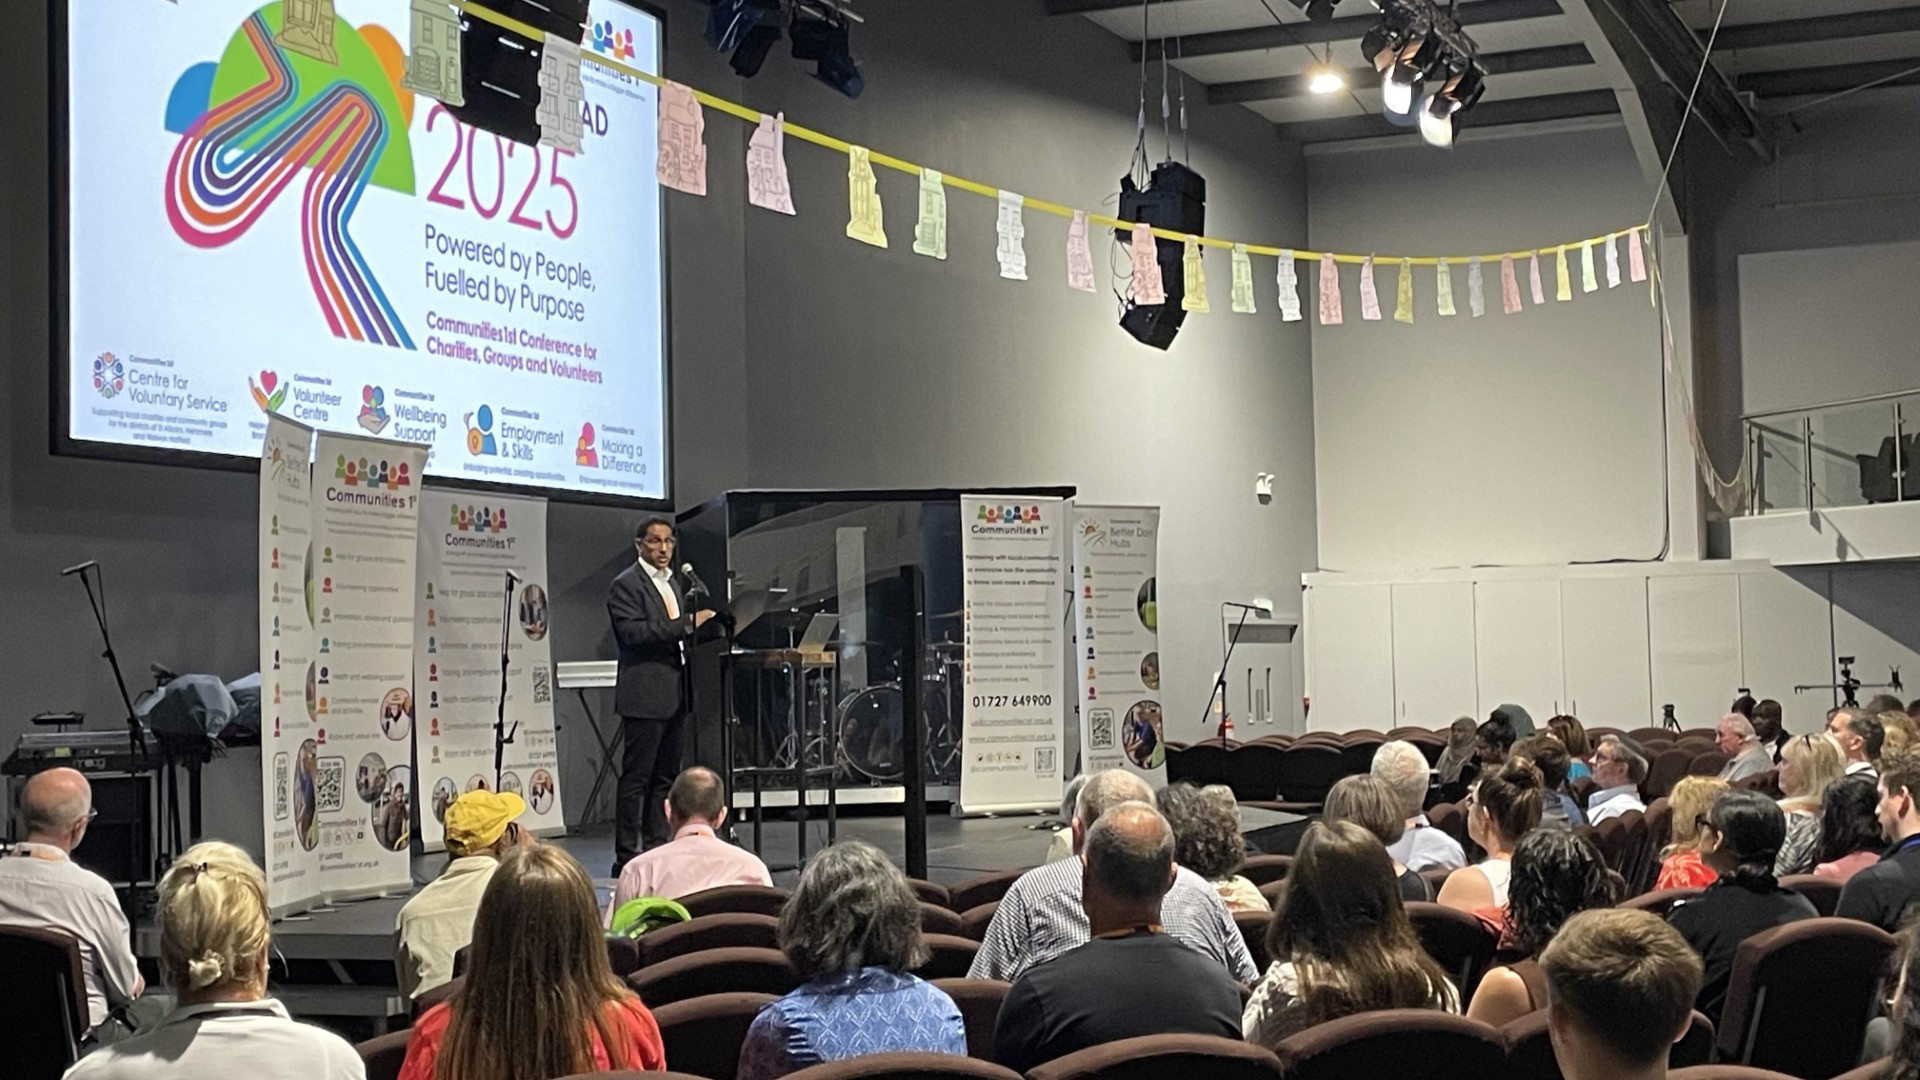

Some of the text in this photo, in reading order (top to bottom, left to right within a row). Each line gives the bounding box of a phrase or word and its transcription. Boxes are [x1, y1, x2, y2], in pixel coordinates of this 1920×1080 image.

[427, 103, 578, 240] 2025
[425, 223, 596, 292] Powered by People,
[425, 261, 585, 322] Fuelled by Purpose
[519, 329, 582, 358] Conference
[584, 342, 598, 361] for
[426, 335, 603, 384] Charities, Groups and Volunteers
[128, 369, 189, 390] Centre for
[128, 387, 228, 413] Voluntary Service
[293, 387, 342, 407] Volunteer
[293, 404, 329, 422] Centre
[394, 404, 447, 429] Wellbeing
[394, 423, 437, 444] Support
[501, 422, 564, 445] Employment
[501, 444, 534, 461] & Skills
[602, 440, 643, 459] Making a
[602, 455, 647, 475] Difference
[326, 487, 405, 509] Communities
[971, 525, 1038, 535] Communities
[1110, 527, 1135, 538] Better
[445, 533, 505, 549] Communities
[973, 694, 1052, 708] 01727 649900
